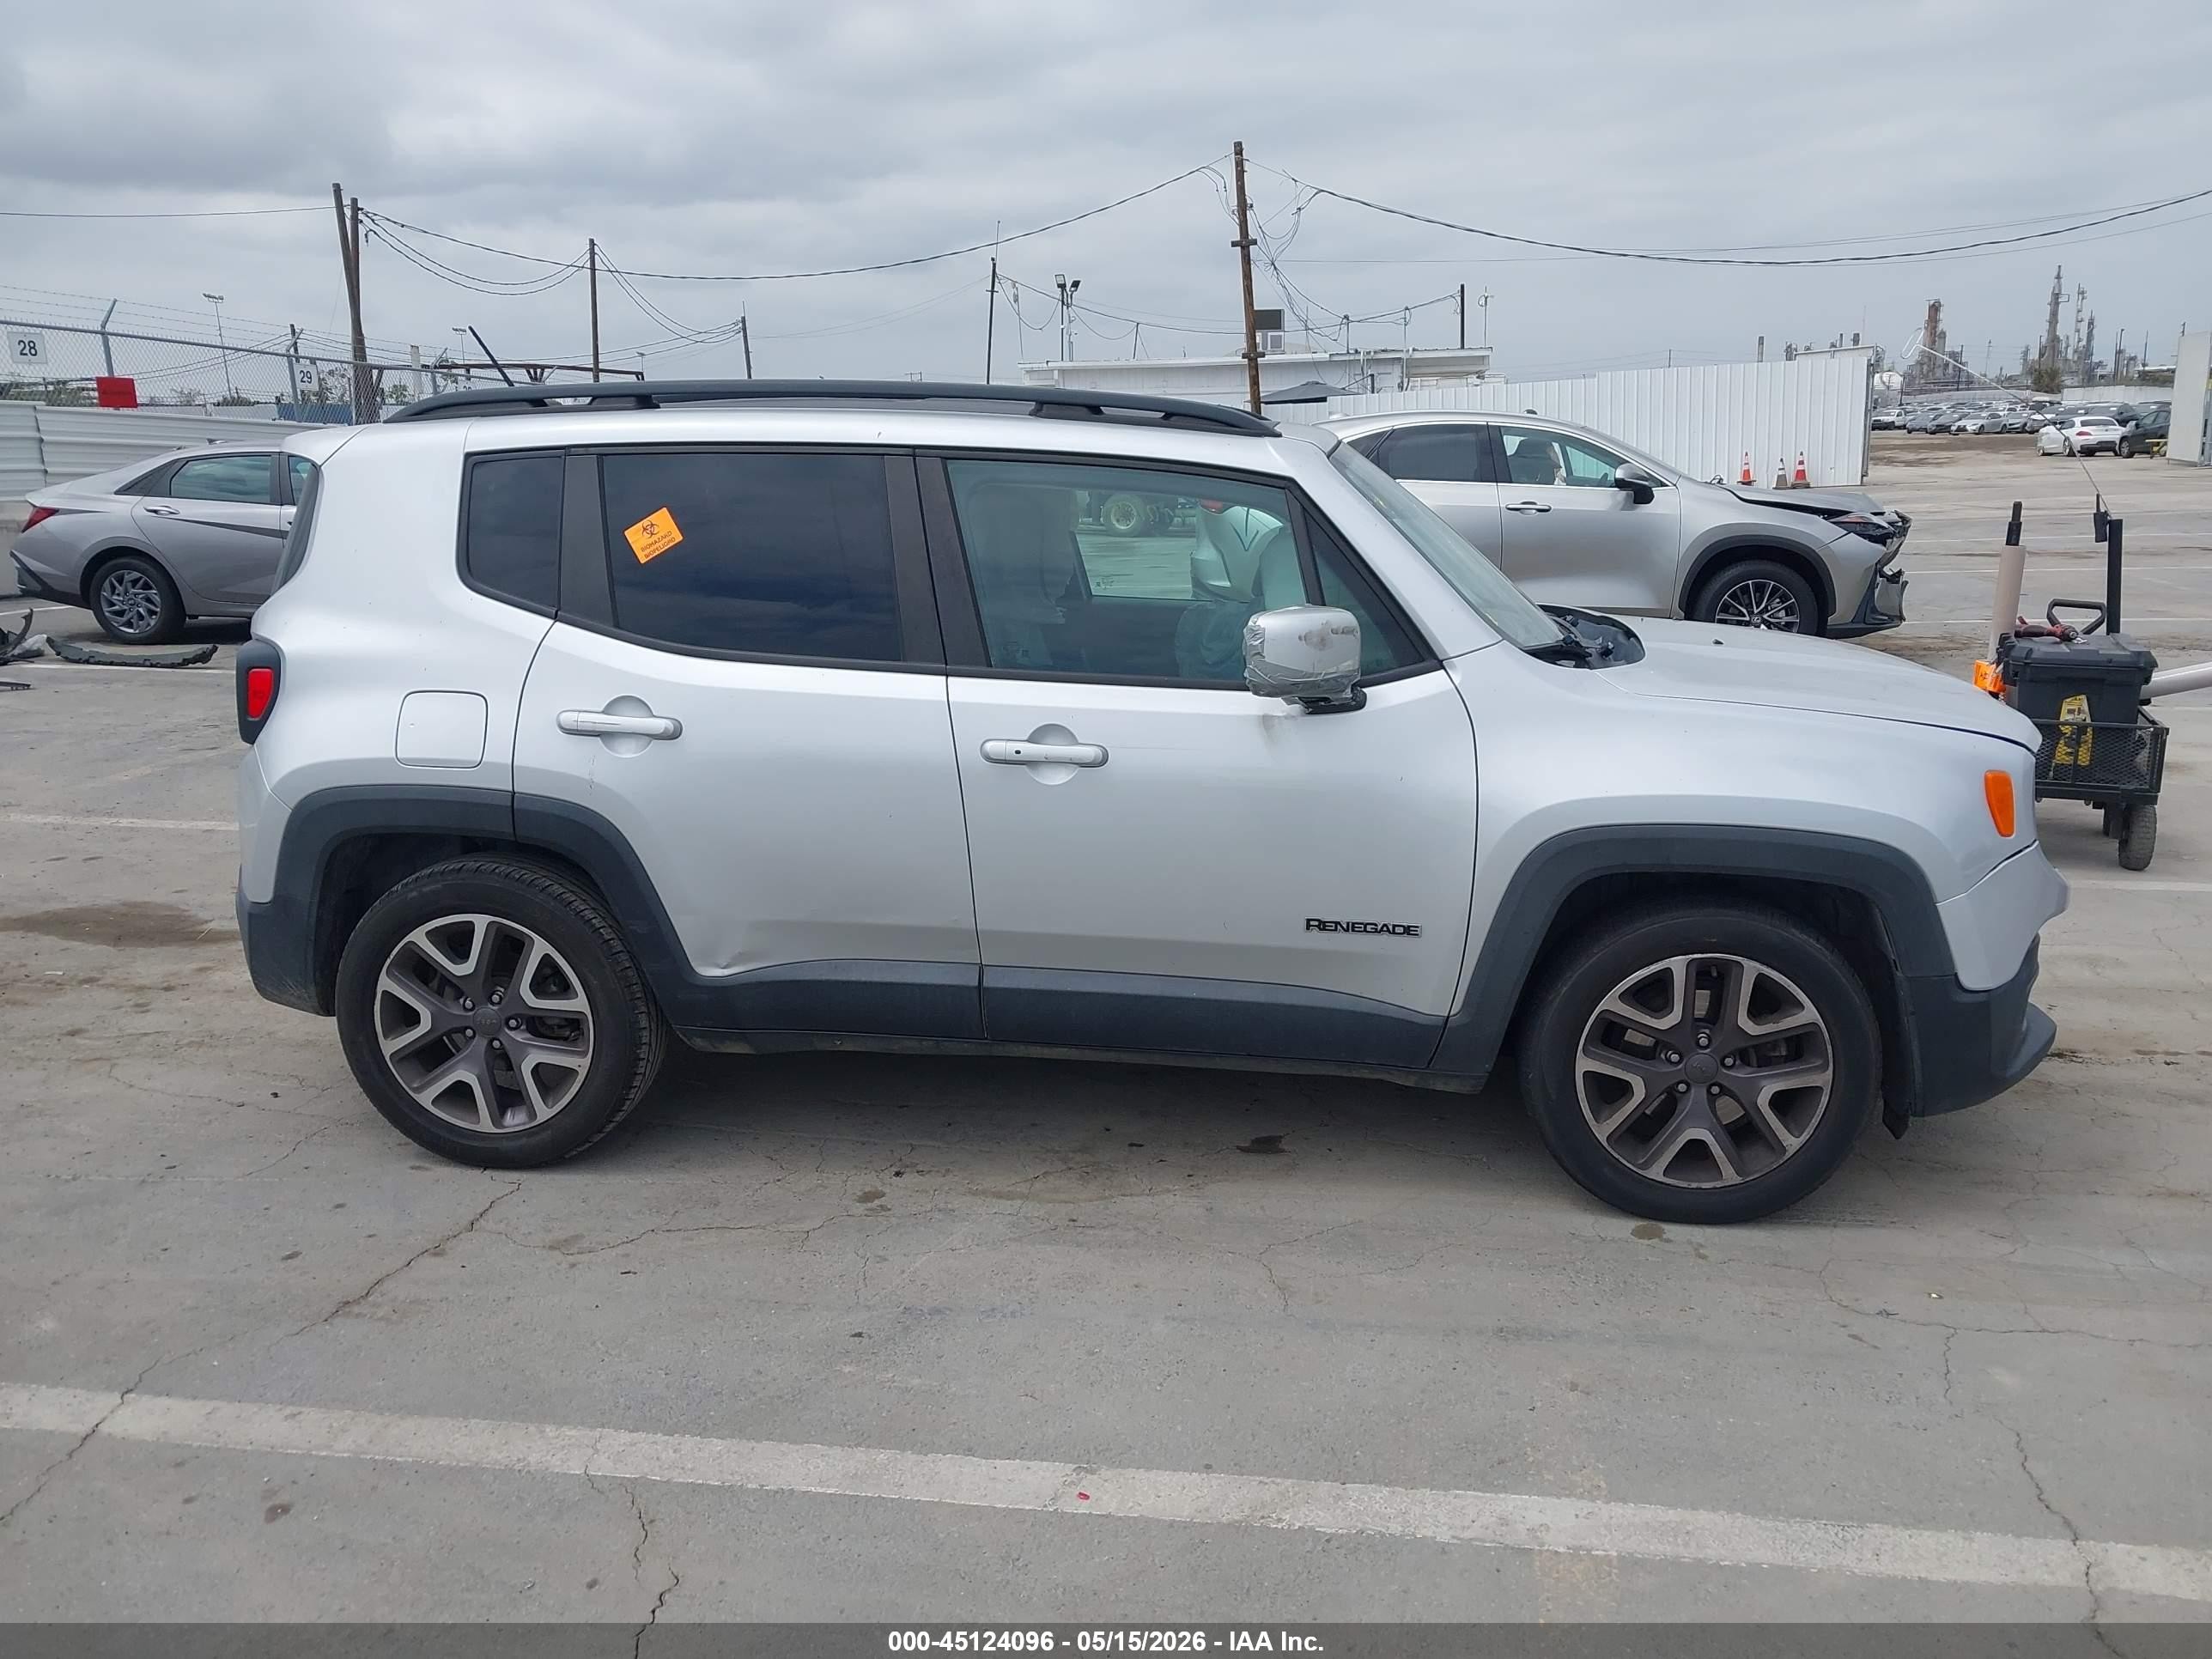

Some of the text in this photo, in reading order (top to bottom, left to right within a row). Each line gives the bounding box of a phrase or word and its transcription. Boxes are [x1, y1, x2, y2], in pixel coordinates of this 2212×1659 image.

[18, 339, 38, 356] 28
[299, 370, 313, 384] 29
[641, 531, 672, 552] BIOHAZARD
[644, 537, 676, 559] BIOPELIGRO
